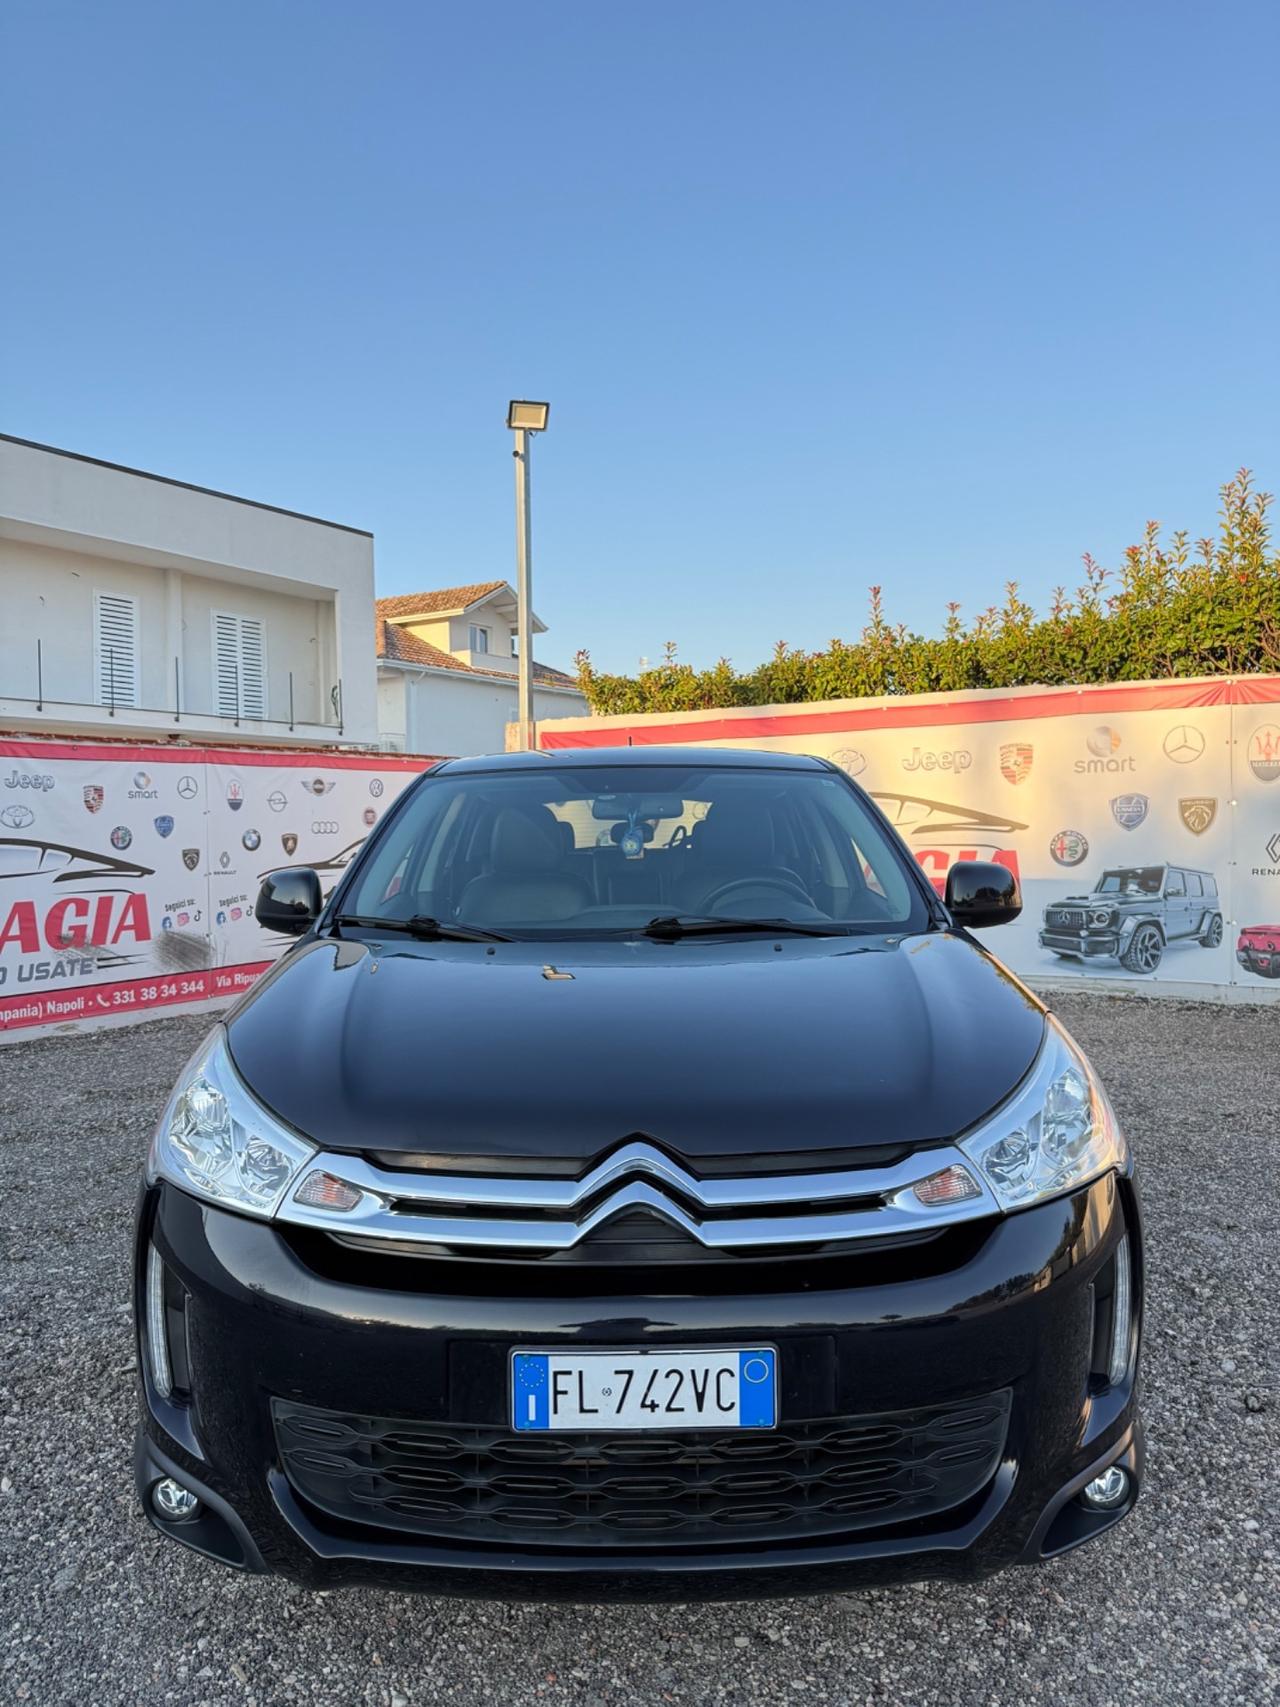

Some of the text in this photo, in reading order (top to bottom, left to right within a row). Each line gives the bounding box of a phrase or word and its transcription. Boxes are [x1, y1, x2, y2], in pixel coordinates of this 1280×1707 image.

[901, 747, 973, 774] Jeep
[1073, 756, 1137, 774] smart
[4, 770, 55, 792] Jeep
[127, 789, 158, 799] smart
[17, 957, 94, 983] USATE
[216, 975, 232, 988] Via
[47, 997, 84, 1015] Napoli
[112, 989, 136, 1005] 331
[140, 986, 158, 1001] 38
[161, 983, 178, 998] 34
[181, 979, 205, 995] 344
